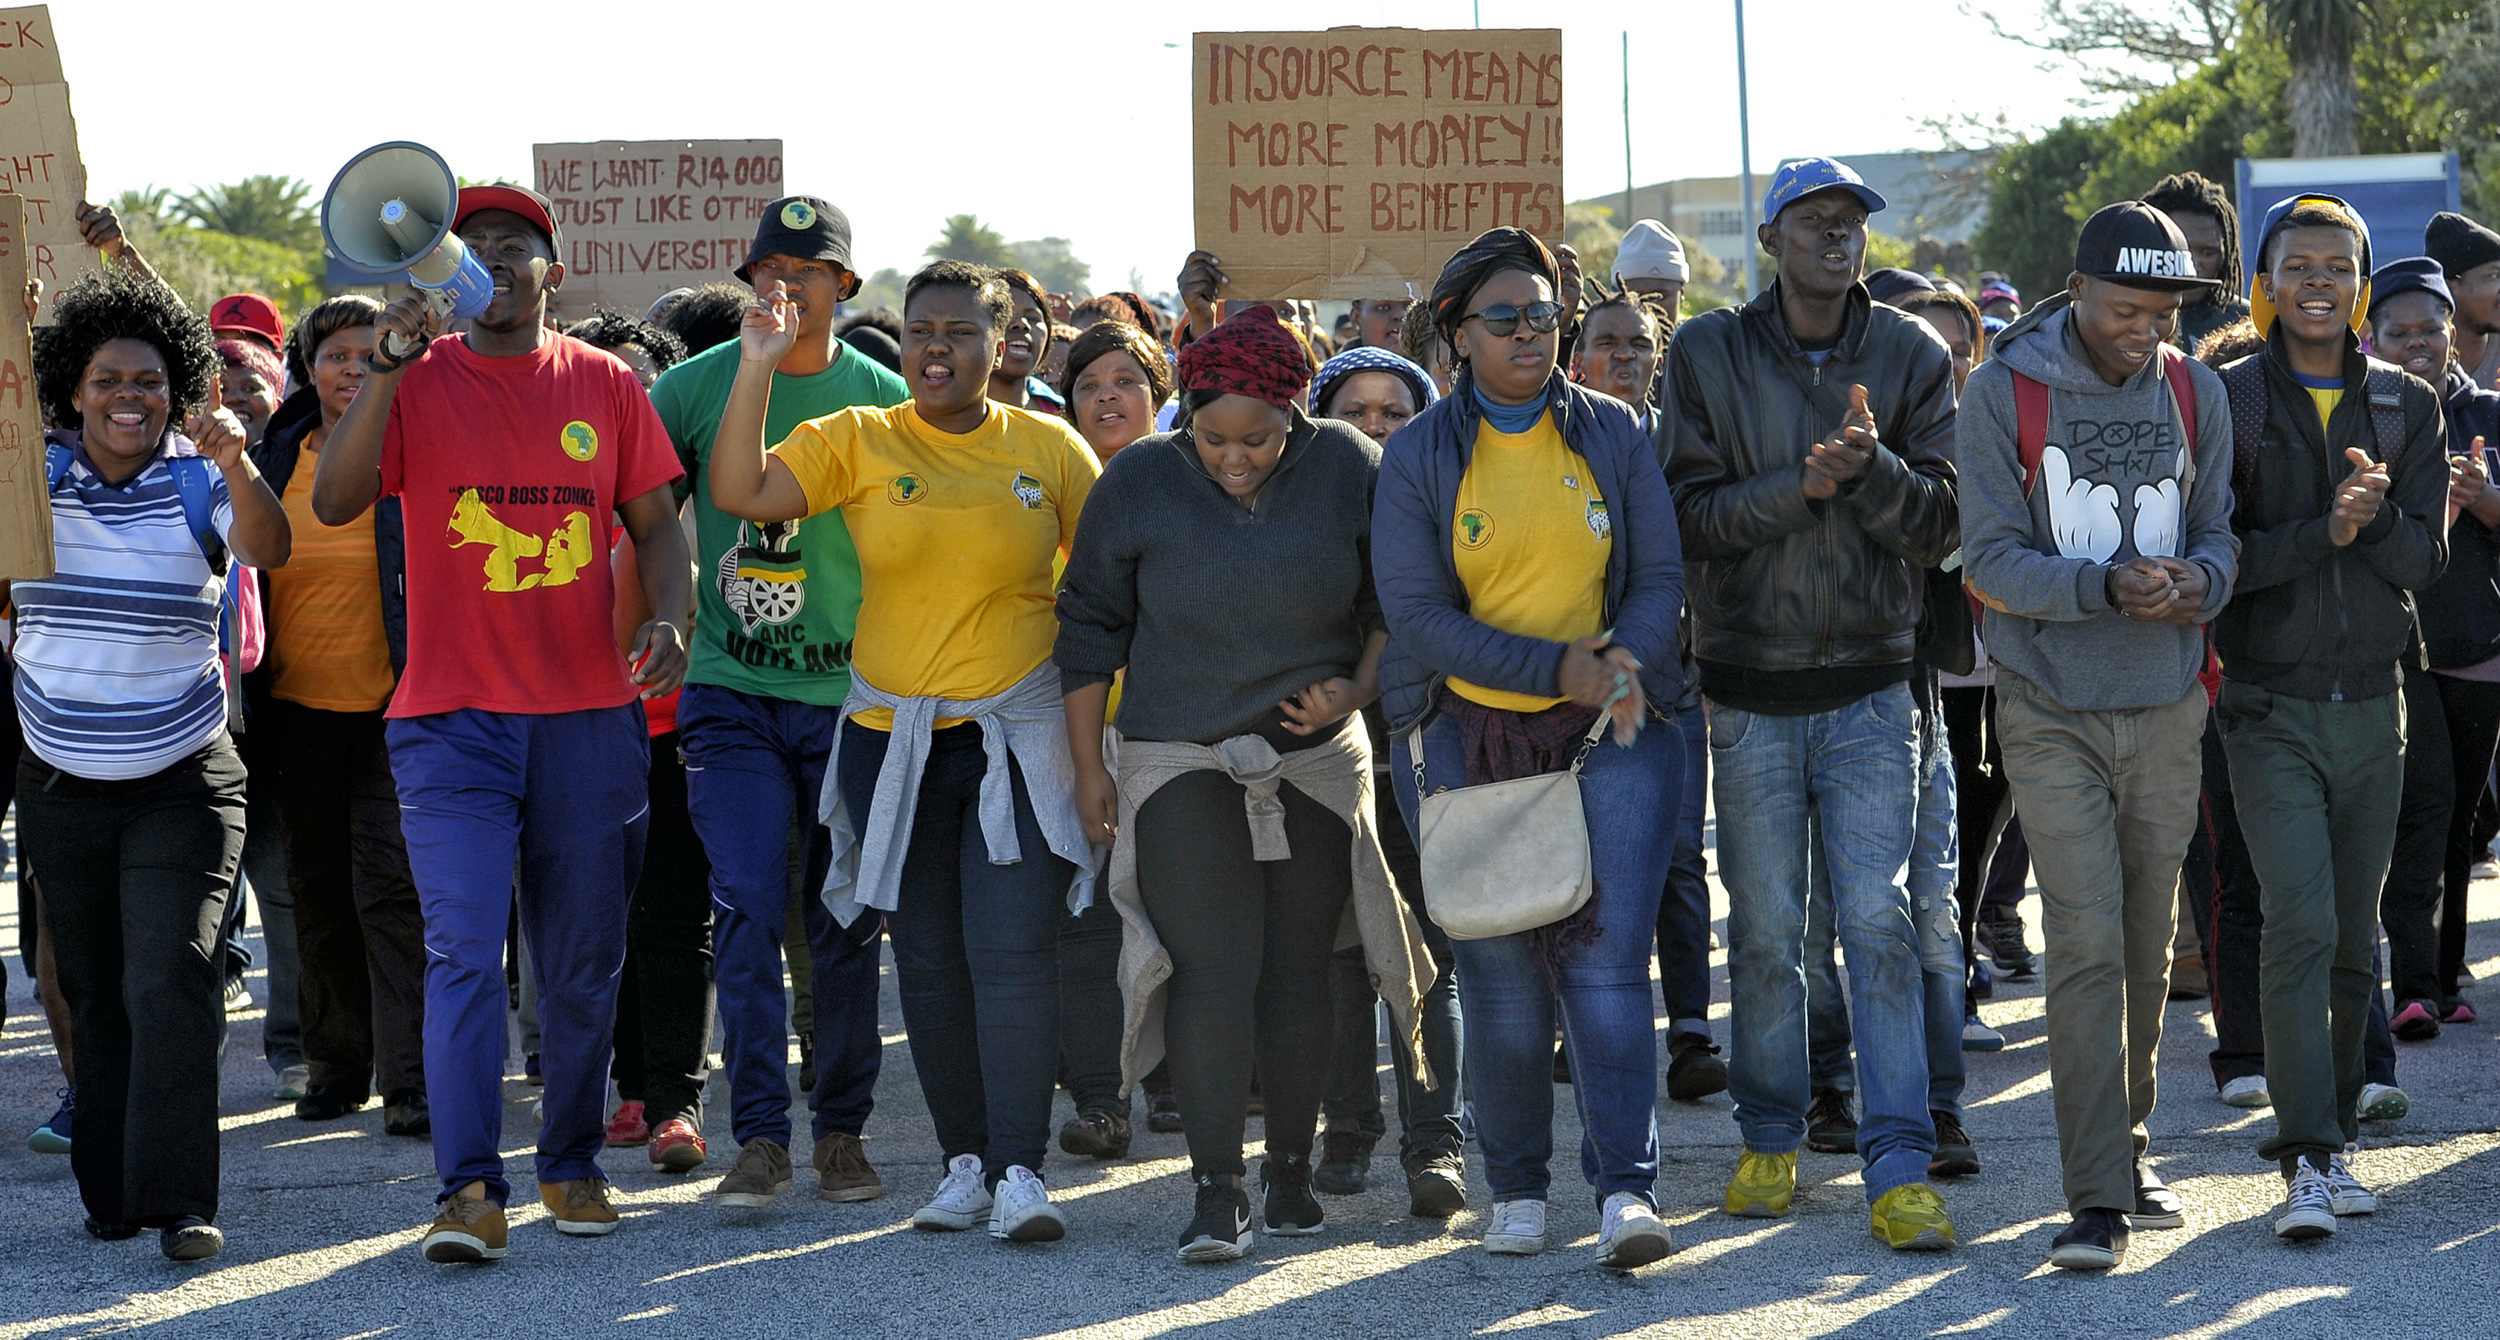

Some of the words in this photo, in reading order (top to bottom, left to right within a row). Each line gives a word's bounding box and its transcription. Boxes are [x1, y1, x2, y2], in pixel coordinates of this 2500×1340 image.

[1208, 43, 1408, 106] INSOURCE
[1422, 48, 1561, 108] MEANS
[1228, 121, 1349, 168] MORE
[541, 160, 583, 194] WE
[553, 197, 624, 227] JUST
[635, 194, 692, 225] LIKE
[1229, 184, 1346, 237] MORE
[2066, 420, 2175, 449] DOPE
[509, 486, 549, 505] BOSS
[553, 486, 596, 508] ZONKE
[726, 629, 798, 672] VOTE
[760, 623, 806, 645] ANC
